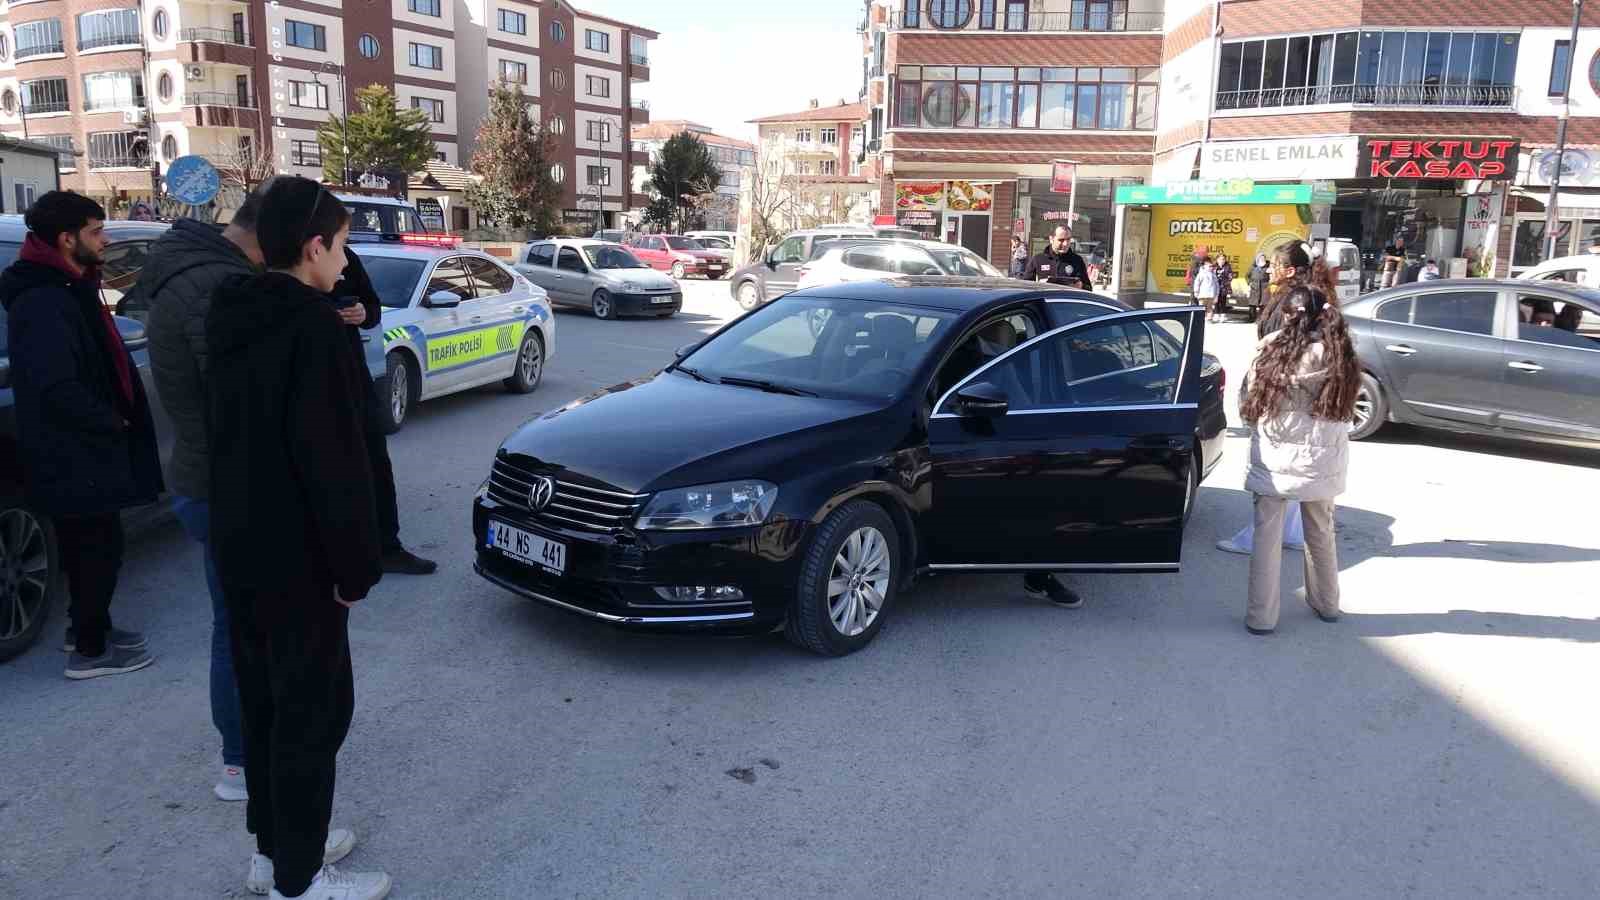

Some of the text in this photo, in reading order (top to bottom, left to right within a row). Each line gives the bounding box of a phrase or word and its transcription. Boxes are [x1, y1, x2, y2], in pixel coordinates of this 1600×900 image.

[1277, 143, 1344, 160] EMLAK
[1366, 140, 1515, 158] TEKTUT
[1371, 161, 1505, 179] KASAP
[429, 332, 482, 361] TRAFİK POLİSİ
[497, 526, 509, 547] 44
[542, 541, 561, 567] 441
